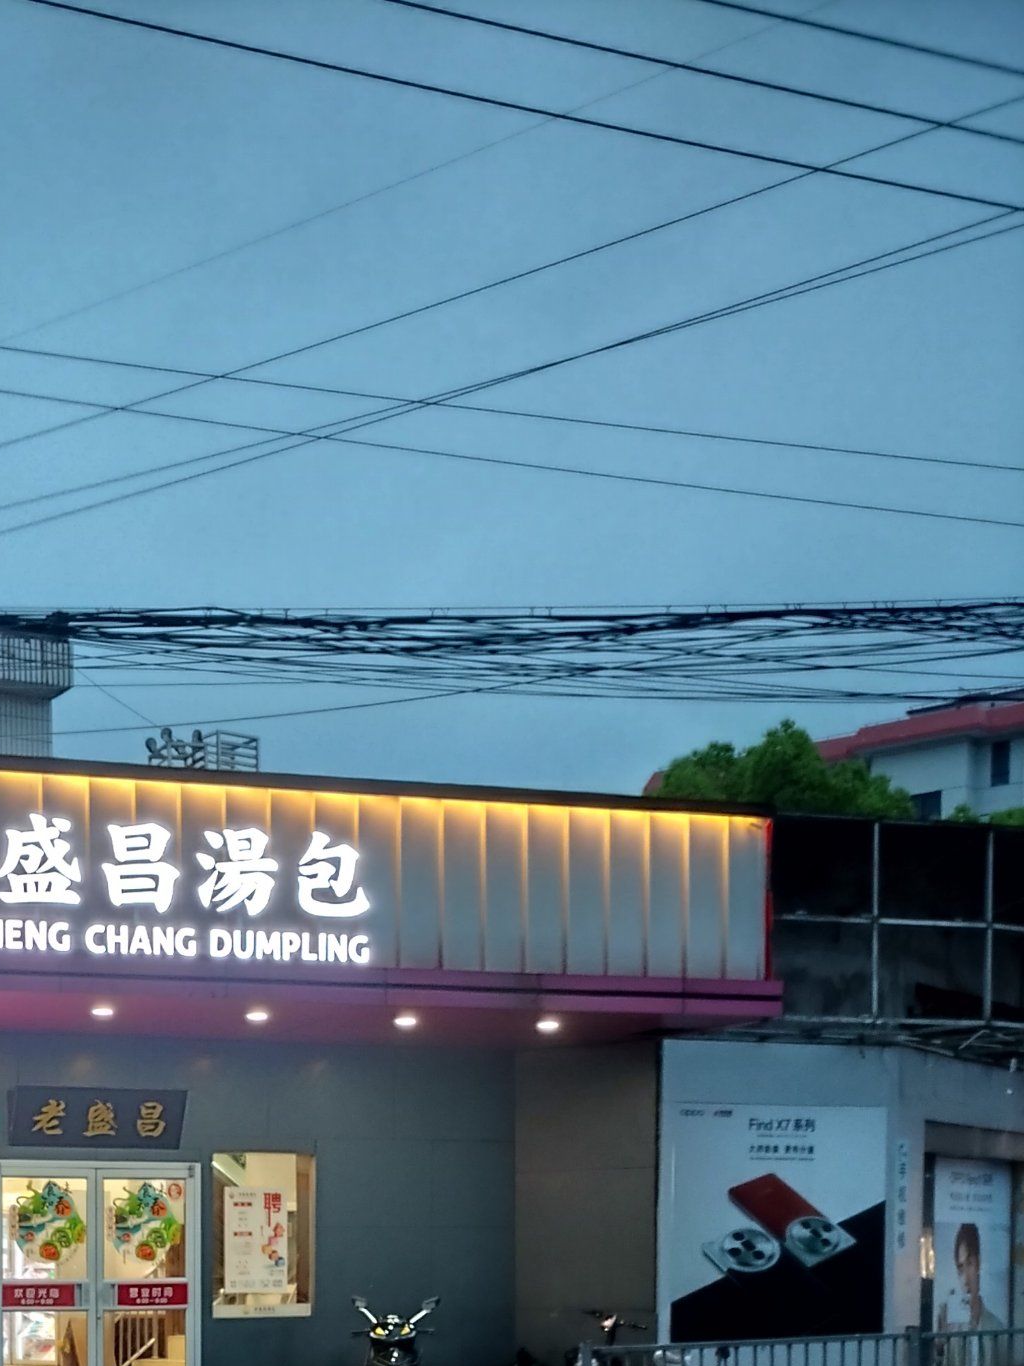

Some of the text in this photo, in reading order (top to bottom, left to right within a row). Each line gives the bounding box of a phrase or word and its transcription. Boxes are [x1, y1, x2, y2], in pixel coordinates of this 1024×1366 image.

[84, 922, 197, 958] CHANG
[208, 927, 371, 964] DUMPLING
[31, 1099, 166, 1138] 老盛昌
[748, 1118, 774, 1131] Find
[775, 1119, 791, 1131] X7
